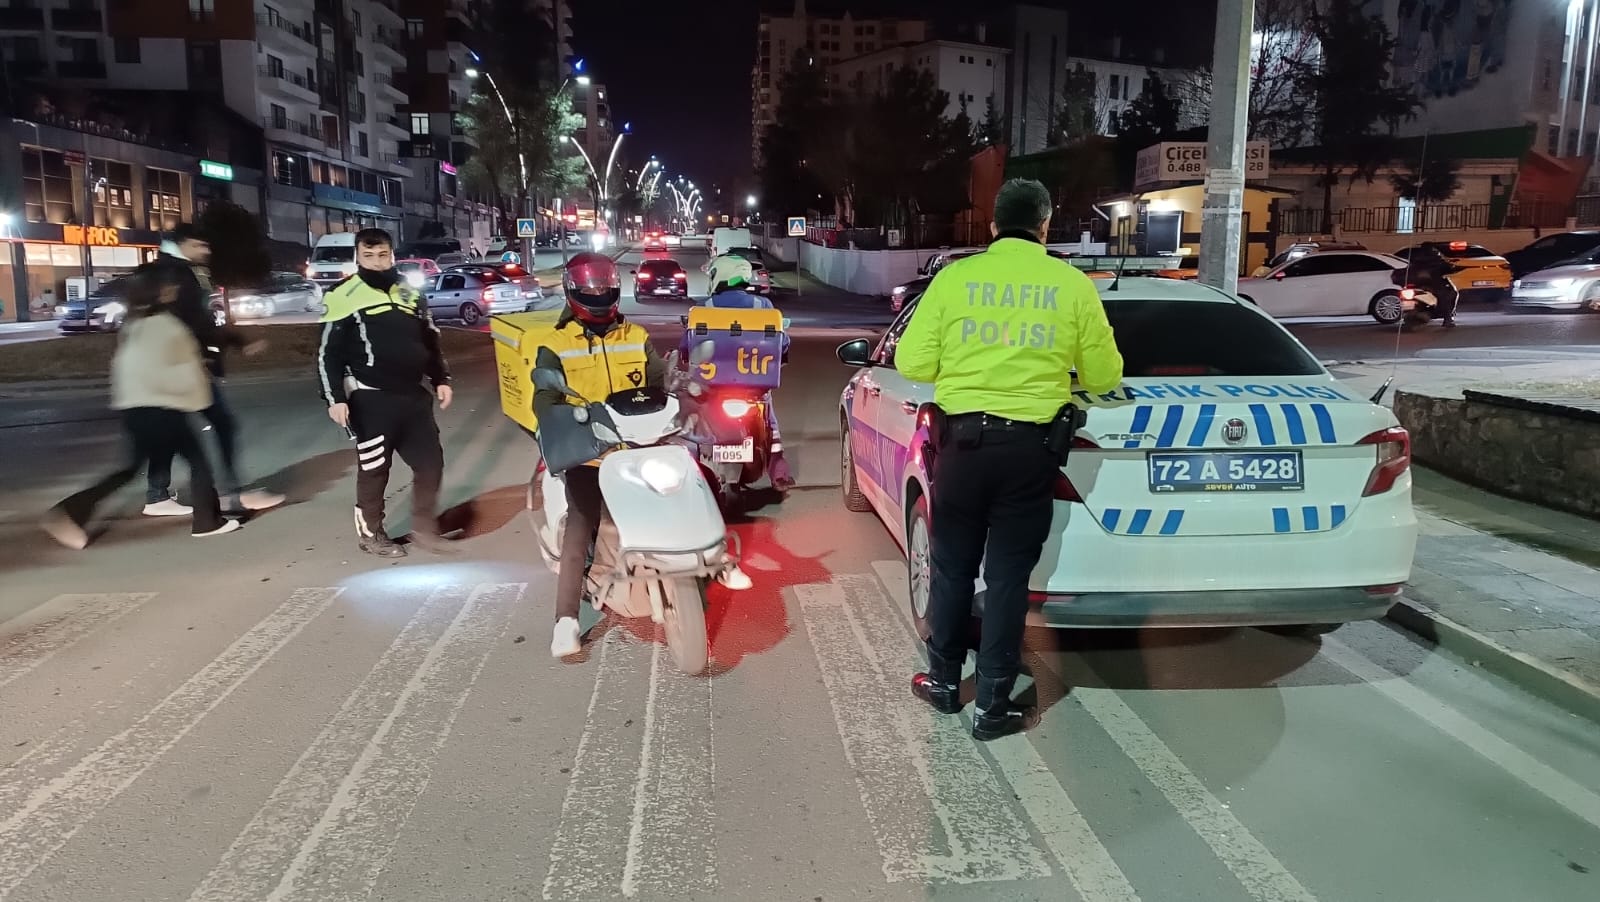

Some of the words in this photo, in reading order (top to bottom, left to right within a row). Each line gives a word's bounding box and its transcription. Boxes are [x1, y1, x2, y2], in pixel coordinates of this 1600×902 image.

[1167, 163, 1201, 172] 0.488
[722, 451, 742, 460] 095
[1156, 460, 1191, 481] 72
[1199, 460, 1220, 480] A
[1228, 458, 1295, 480] 5428
